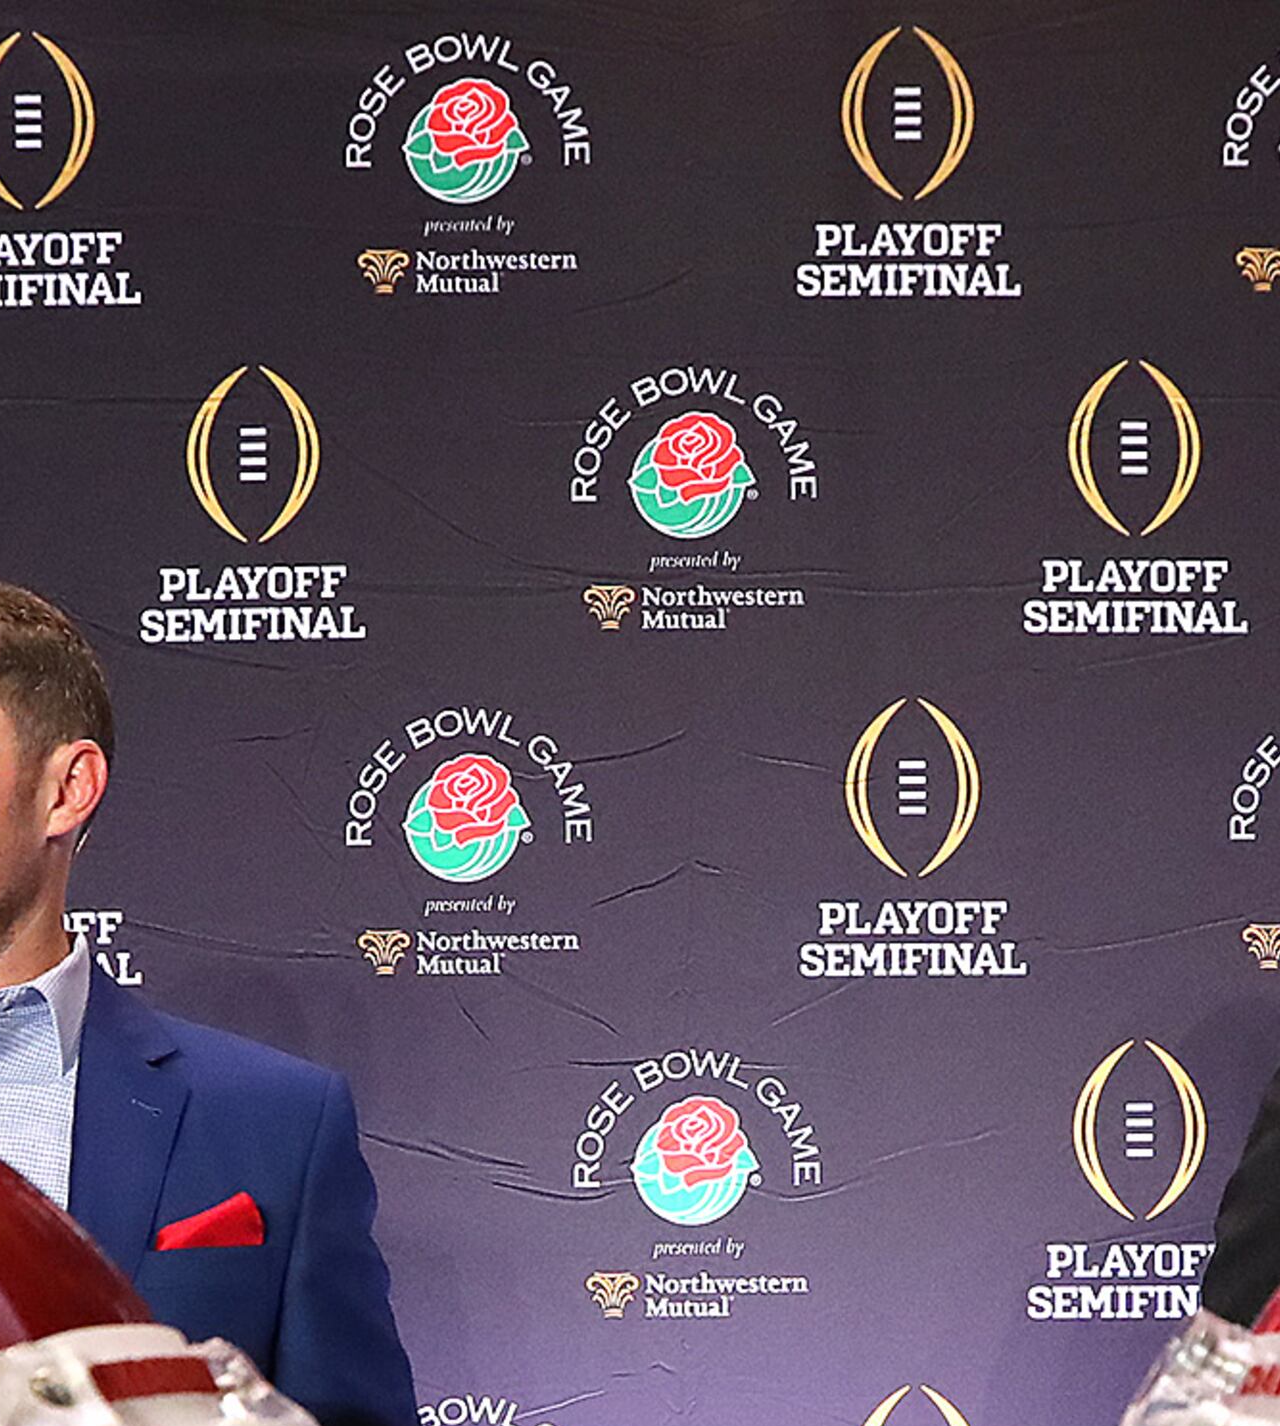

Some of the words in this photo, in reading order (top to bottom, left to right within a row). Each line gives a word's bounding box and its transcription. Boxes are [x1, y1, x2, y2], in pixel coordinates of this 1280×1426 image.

[346, 65, 405, 168] ROSE
[405, 33, 519, 74] BOWL
[527, 61, 590, 166] GAME
[424, 215, 492, 237] presented
[496, 215, 515, 235] by
[815, 223, 1001, 256] PLAYOFF
[416, 249, 577, 271] Northwestern
[416, 271, 499, 293] Mutual
[797, 263, 1021, 296] SEMIFINAL
[571, 398, 631, 502] ROSE
[631, 367, 745, 407] BOWL
[753, 394, 817, 500] GAME
[649, 551, 719, 572] presented
[722, 551, 741, 571] by
[1042, 560, 1228, 593] PLAYOFF
[160, 565, 346, 601] PLAYOFF
[642, 585, 804, 607] Northwestern
[141, 606, 366, 643] SEMIFINAL
[642, 607, 726, 629] Mutual
[1024, 600, 1248, 633] SEMIFINAL
[346, 740, 406, 846] ROSE
[405, 707, 520, 749] BOWL
[529, 736, 592, 843] GAME
[424, 895, 493, 916] presented
[498, 895, 515, 915] by
[819, 901, 1007, 935] PLAYOFF
[417, 930, 579, 952] Northwestern
[417, 953, 501, 974] Mutual
[800, 943, 1026, 976] SEMIFINAL
[574, 1082, 634, 1187] ROSE
[633, 1049, 748, 1091] BOWL
[757, 1078, 820, 1186] GAME
[653, 1238, 721, 1259] presented
[726, 1238, 744, 1258] by
[1047, 1244, 1216, 1277] PLAYOF
[645, 1272, 808, 1294] Northwestern
[645, 1295, 729, 1317] Mutual
[1028, 1286, 1199, 1319] SEMIFIN
